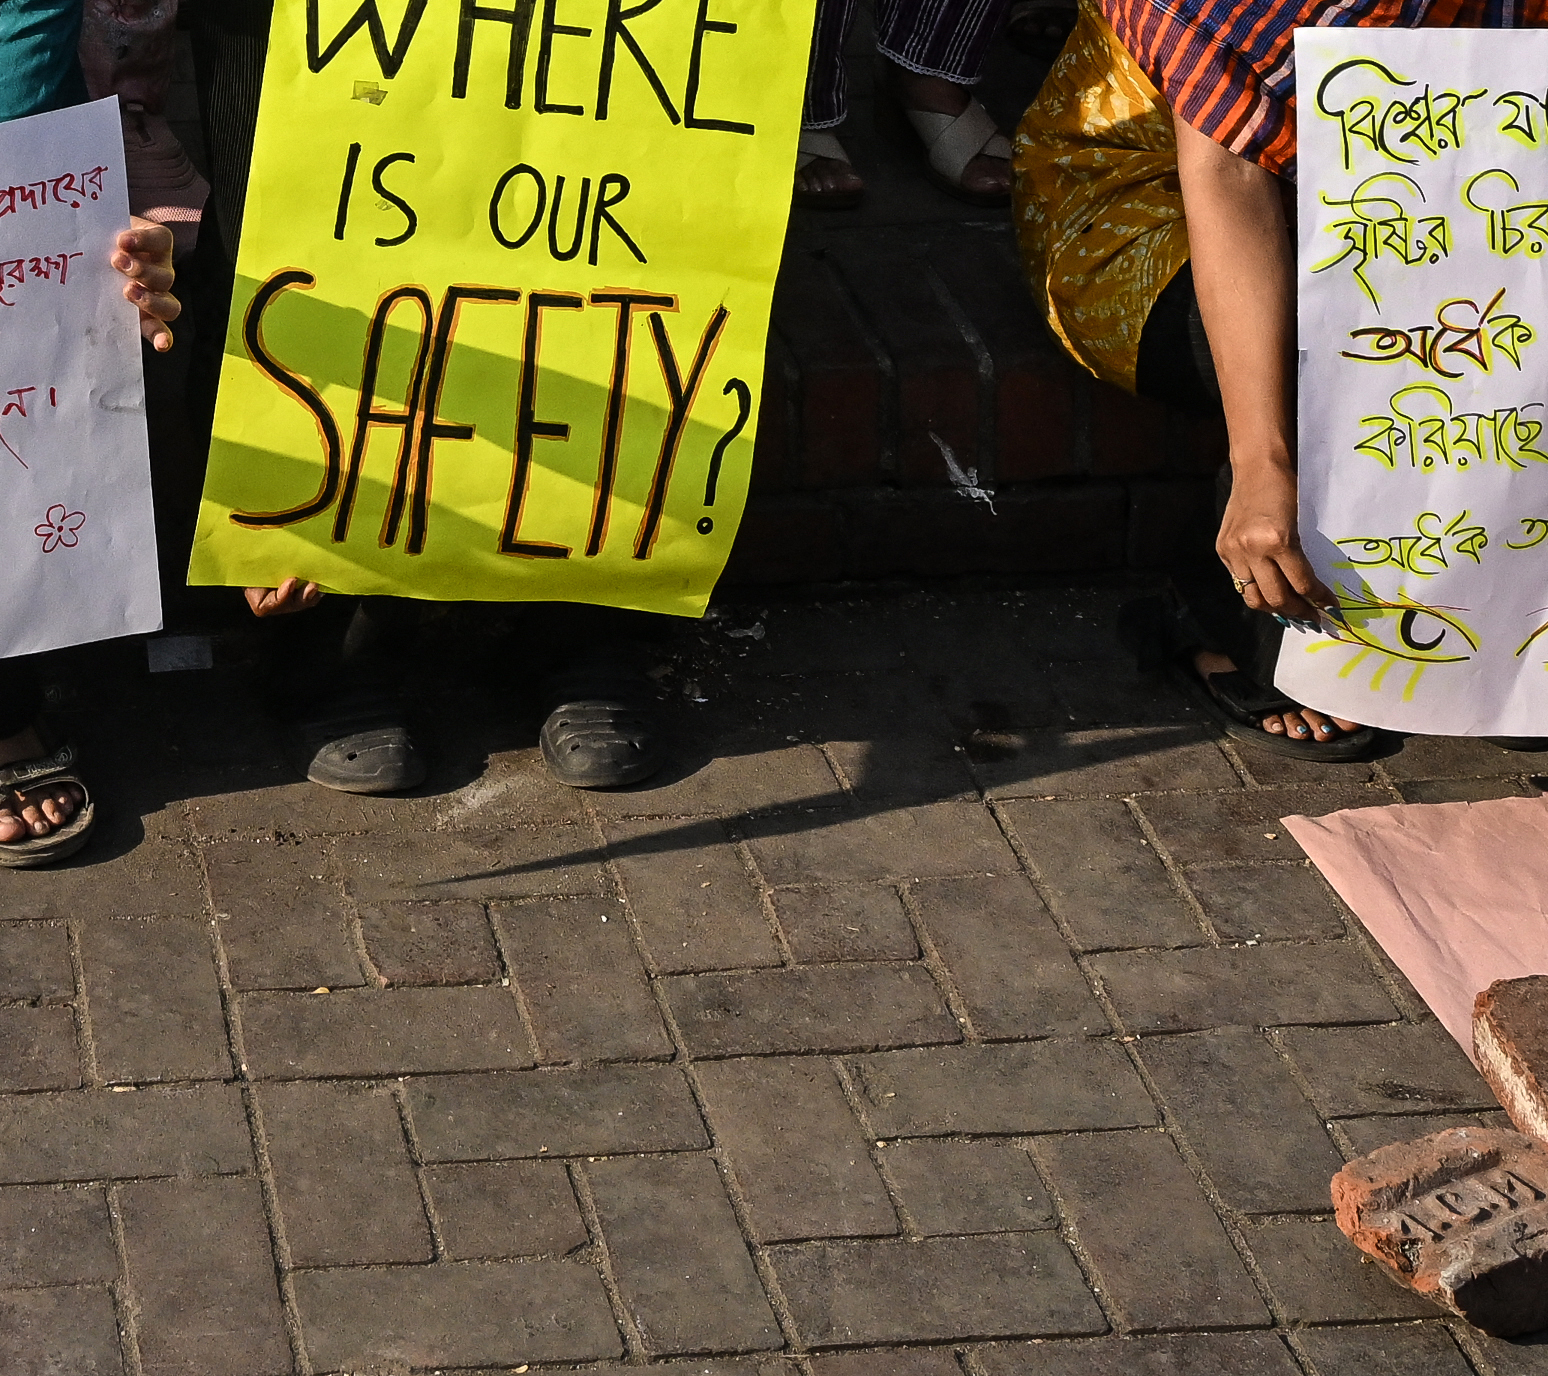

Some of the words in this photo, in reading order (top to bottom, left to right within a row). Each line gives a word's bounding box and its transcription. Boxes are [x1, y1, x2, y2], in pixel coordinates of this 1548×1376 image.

[1317, 58, 1489, 170] বিশ্বের
[333, 141, 417, 247] IS
[488, 162, 648, 266] OUR
[228, 268, 752, 562] SAFETY?
